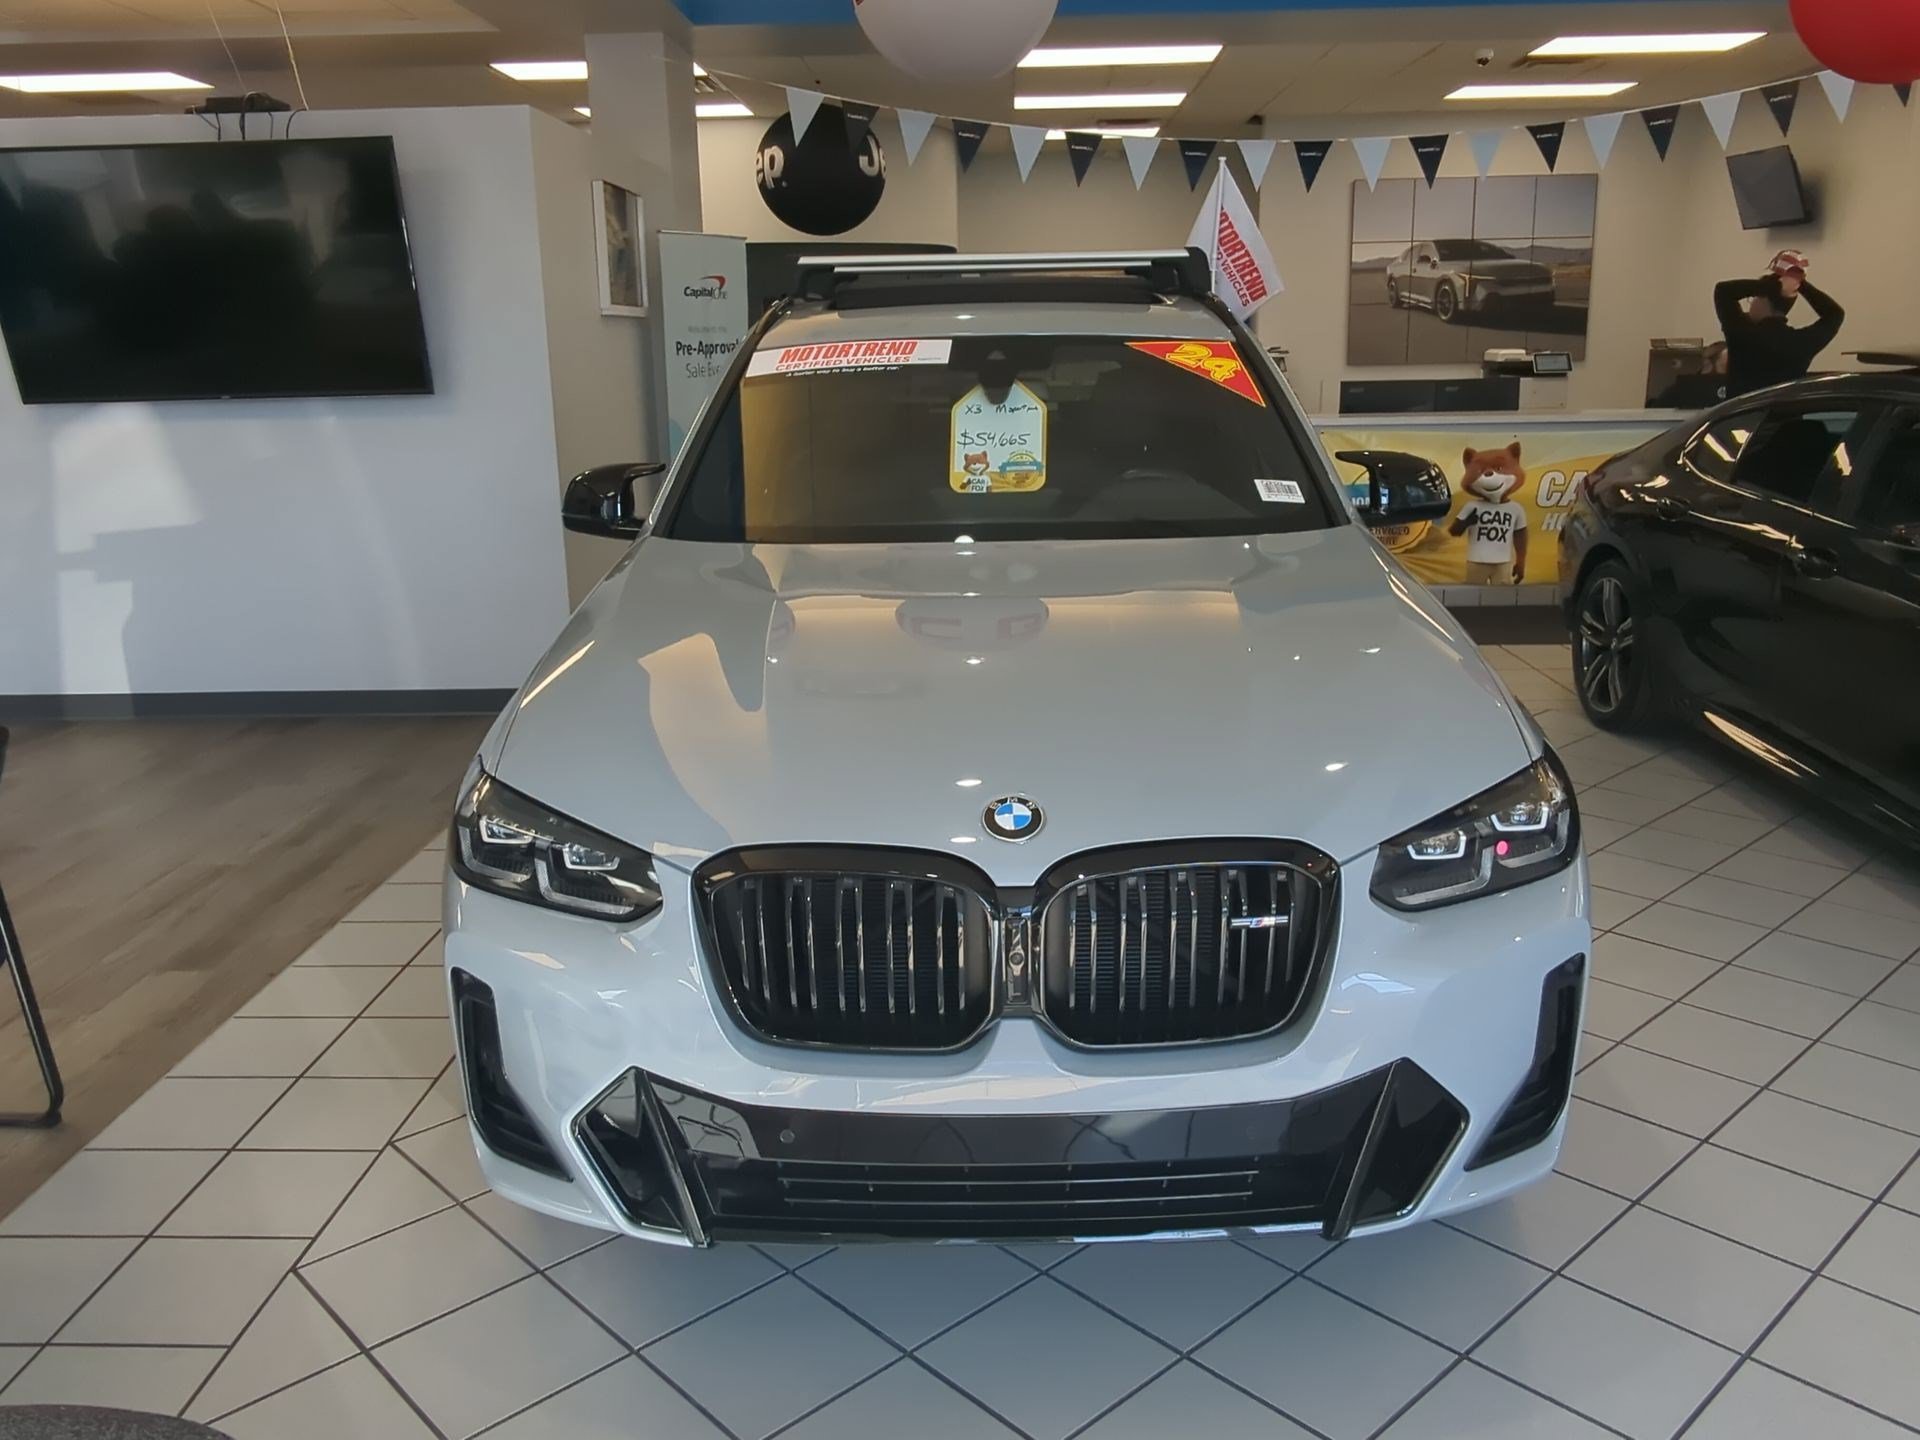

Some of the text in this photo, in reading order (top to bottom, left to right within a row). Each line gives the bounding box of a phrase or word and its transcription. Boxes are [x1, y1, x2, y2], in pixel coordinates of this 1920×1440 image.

[1217, 209, 1268, 303] OTORTREND
[1221, 259, 1250, 307] VEHICLES
[778, 340, 919, 364] MOTORTREND
[1165, 343, 1241, 382] 24
[775, 358, 843, 372] CERTIFIED
[845, 356, 912, 366] VEHICLES
[965, 404, 982, 415] X3
[957, 428, 1031, 449] $54,665
[1480, 510, 1512, 526] CAR
[1477, 526, 1509, 543] FOX
